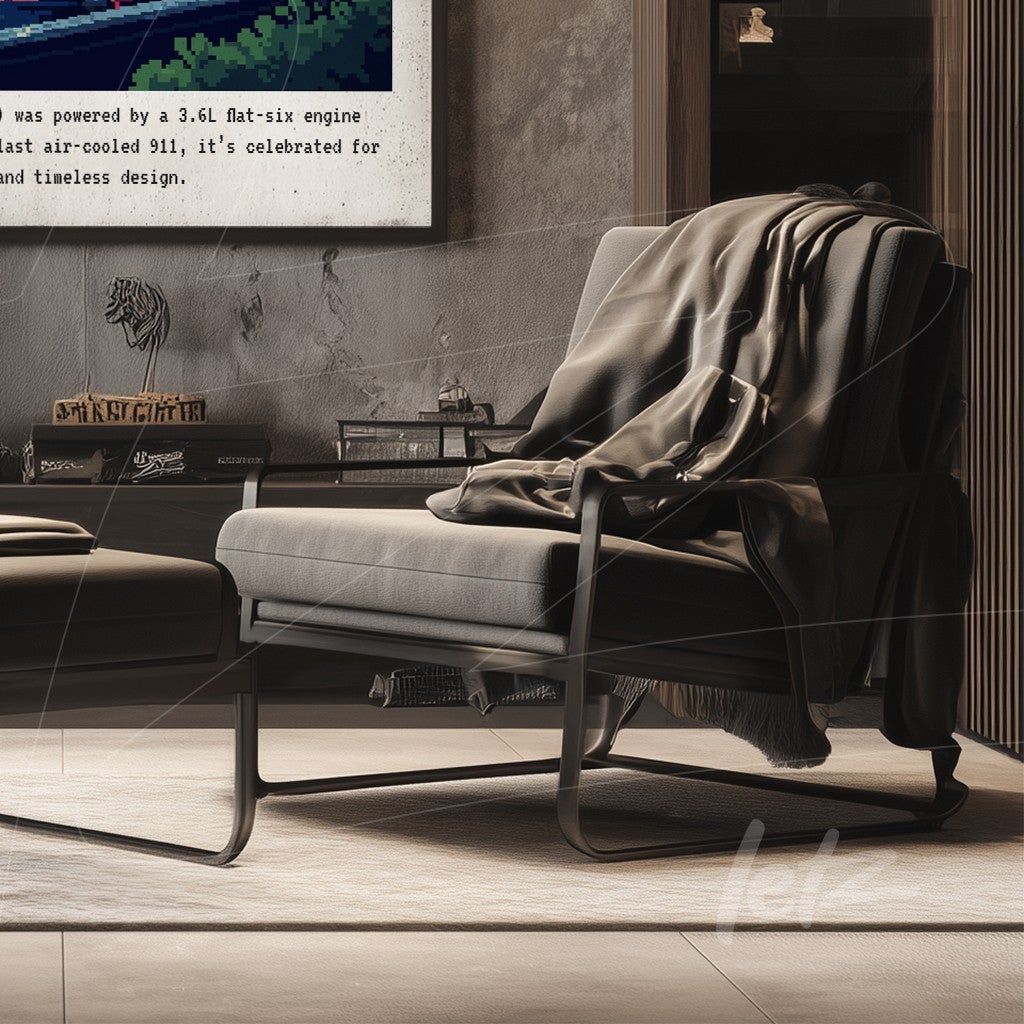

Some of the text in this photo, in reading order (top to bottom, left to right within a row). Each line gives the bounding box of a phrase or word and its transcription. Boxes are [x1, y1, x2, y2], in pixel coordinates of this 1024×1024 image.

[15, 112, 42, 122] was
[54, 108, 119, 126] powered
[131, 108, 148, 126] by
[159, 112, 169, 123] a
[180, 108, 216, 122] 3.6L
[227, 108, 292, 122] flat-six
[304, 108, 360, 126] engine
[44, 139, 139, 153] air-cooled
[151, 139, 185, 157] 911,
[246, 139, 341, 153] celebrated
[353, 139, 379, 153] for
[34, 170, 109, 184] timeless
[121, 170, 185, 188] design.
